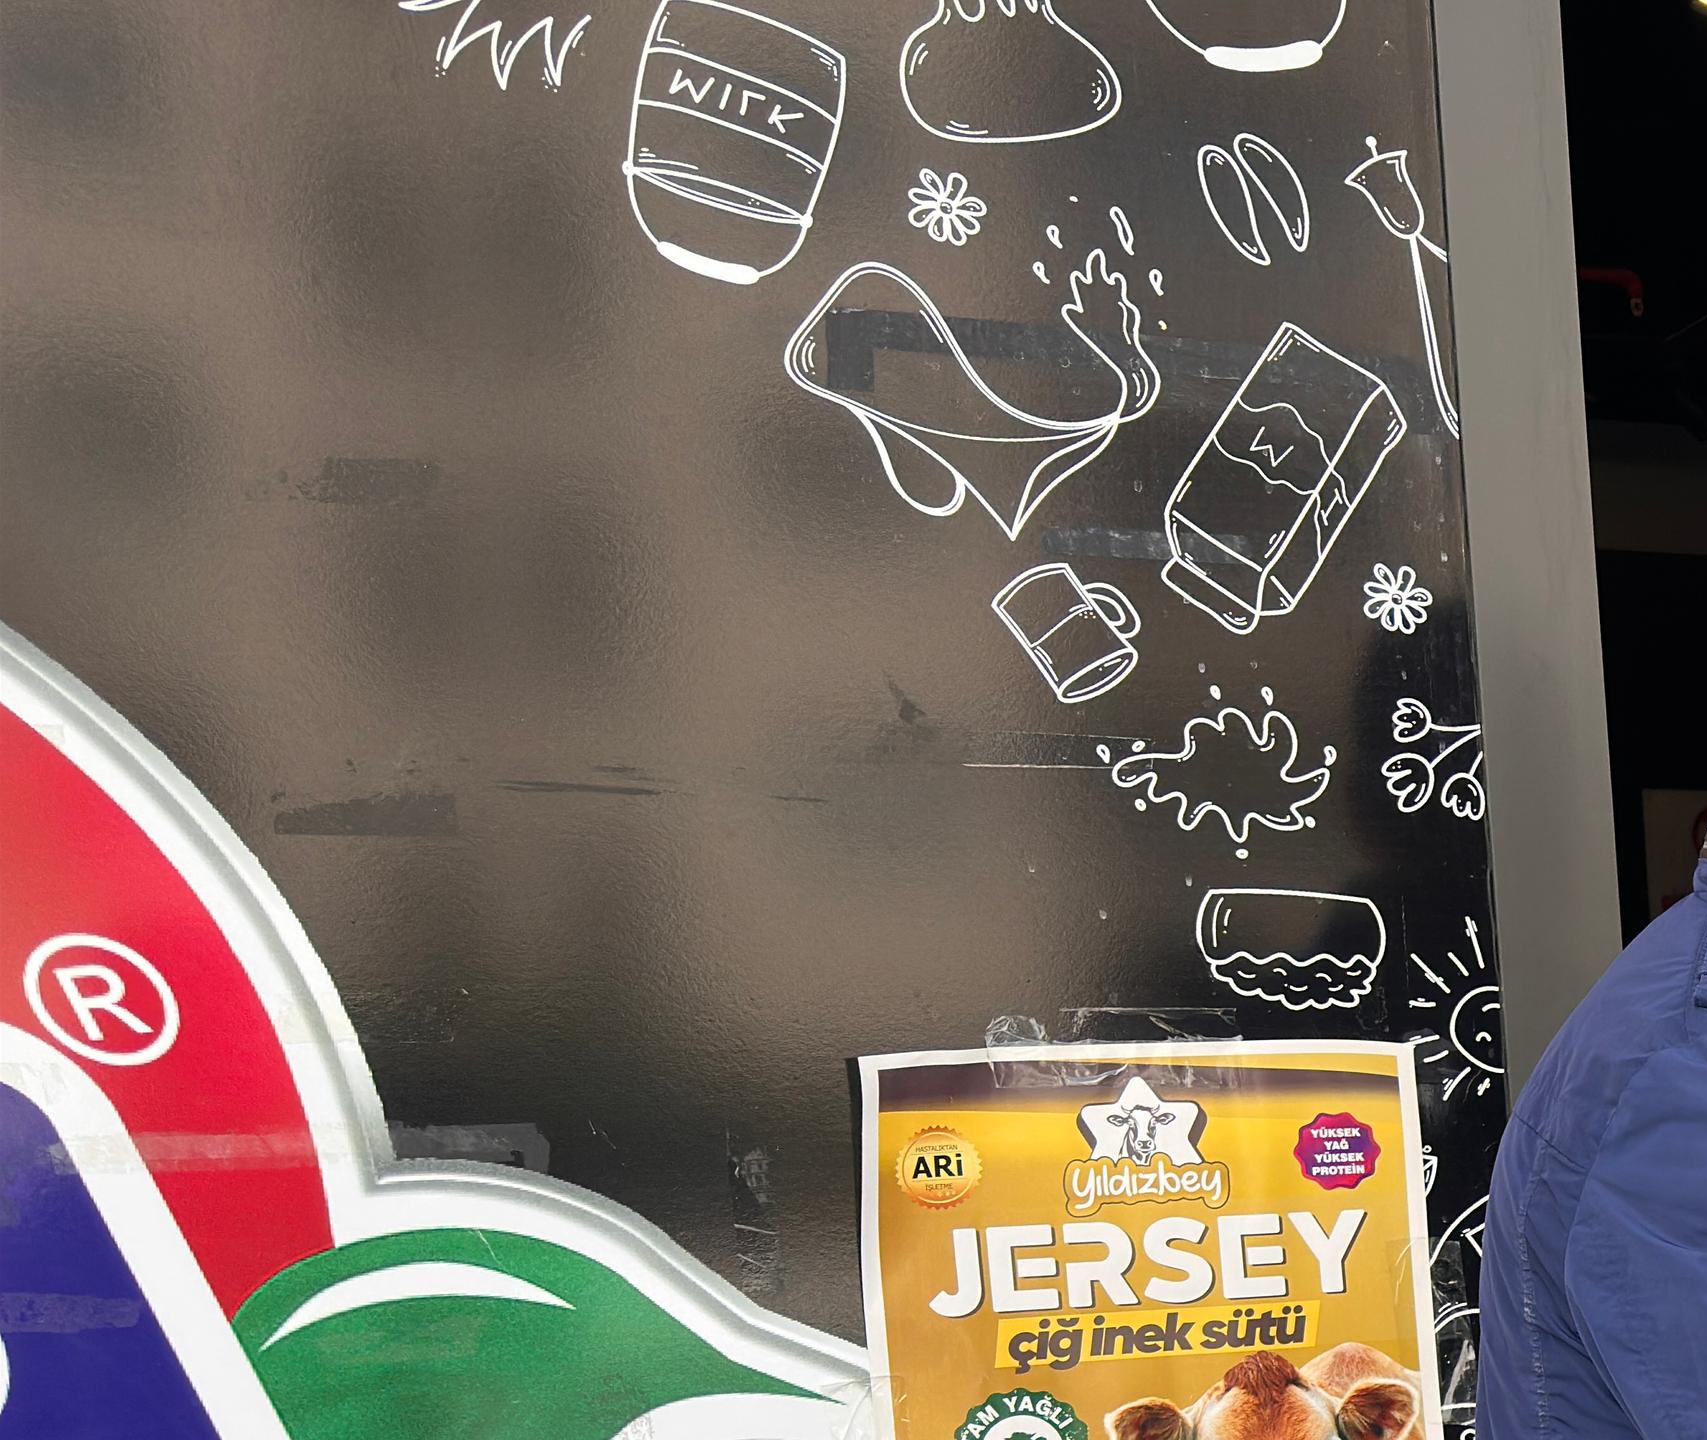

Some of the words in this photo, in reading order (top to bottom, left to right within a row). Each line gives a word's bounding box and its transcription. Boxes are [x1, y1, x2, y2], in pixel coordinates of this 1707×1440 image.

[1310, 1127, 1361, 1138] YÜKSEK
[1324, 1138, 1350, 1150] YAĞ
[1314, 1152, 1364, 1163] YÜKSEK
[1312, 1163, 1365, 1175] PROTEİN
[928, 1209, 1369, 1318] JERSEY
[1007, 1316, 1085, 1374] çiğ
[1091, 1318, 1194, 1354] inek
[1201, 1307, 1308, 1346] sütü
[1003, 1395, 1073, 1429] YAĞLI
